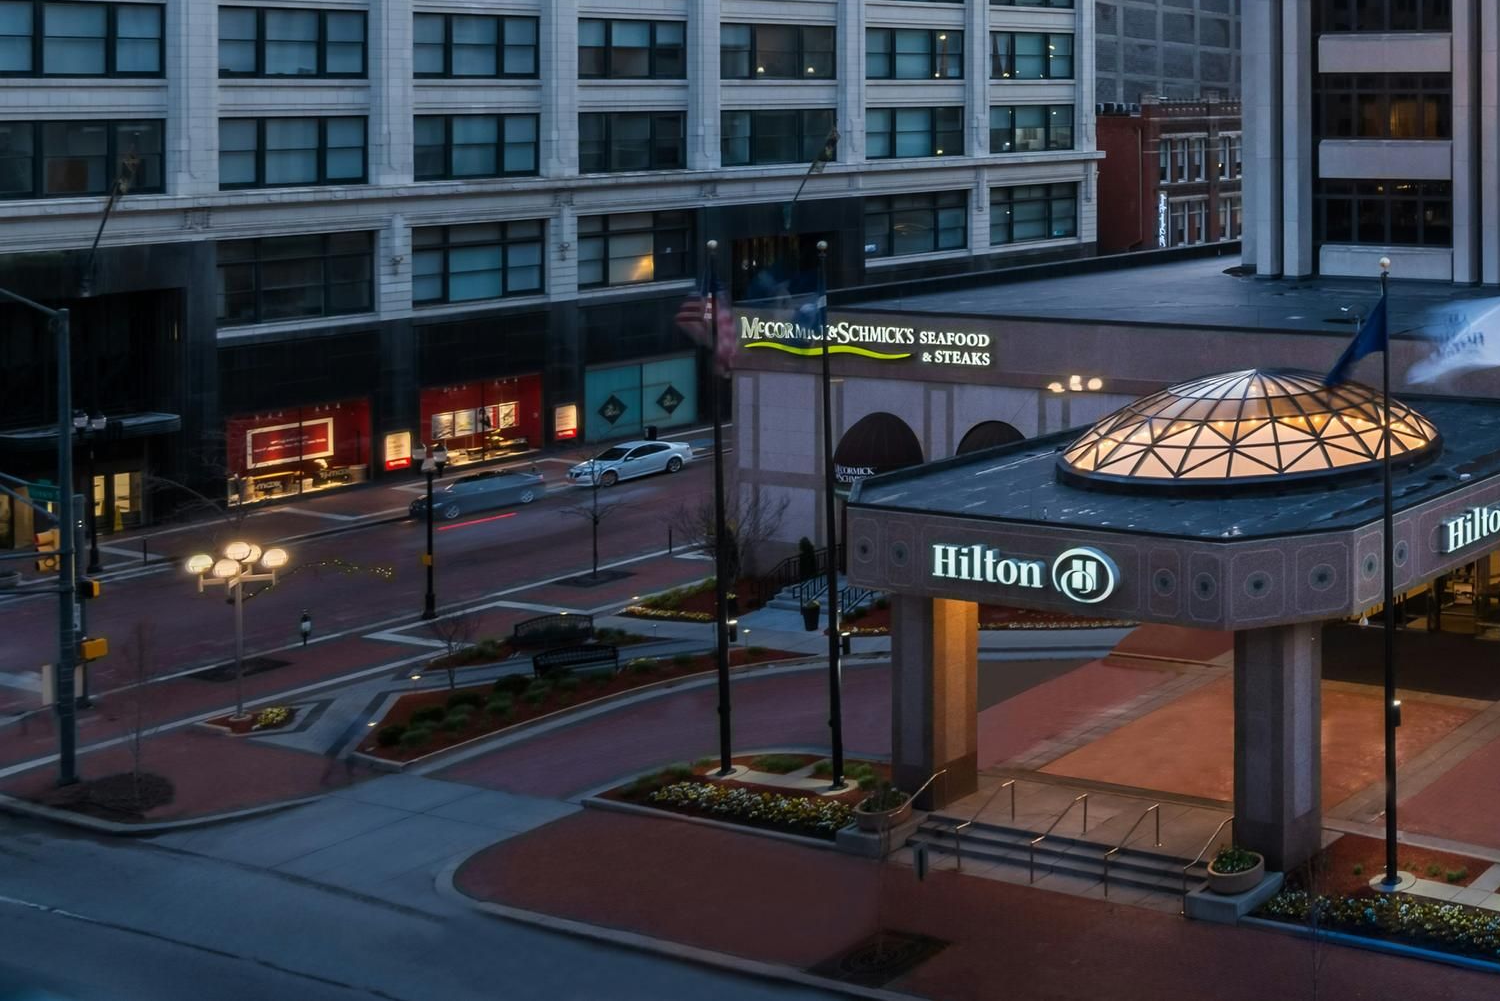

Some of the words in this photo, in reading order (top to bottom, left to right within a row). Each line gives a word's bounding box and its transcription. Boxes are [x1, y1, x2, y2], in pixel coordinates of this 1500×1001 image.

[919, 331, 990, 347] SEAFOOD
[922, 352, 932, 362] &
[934, 350, 990, 366] STEAKS
[932, 544, 1044, 588] Hilton
